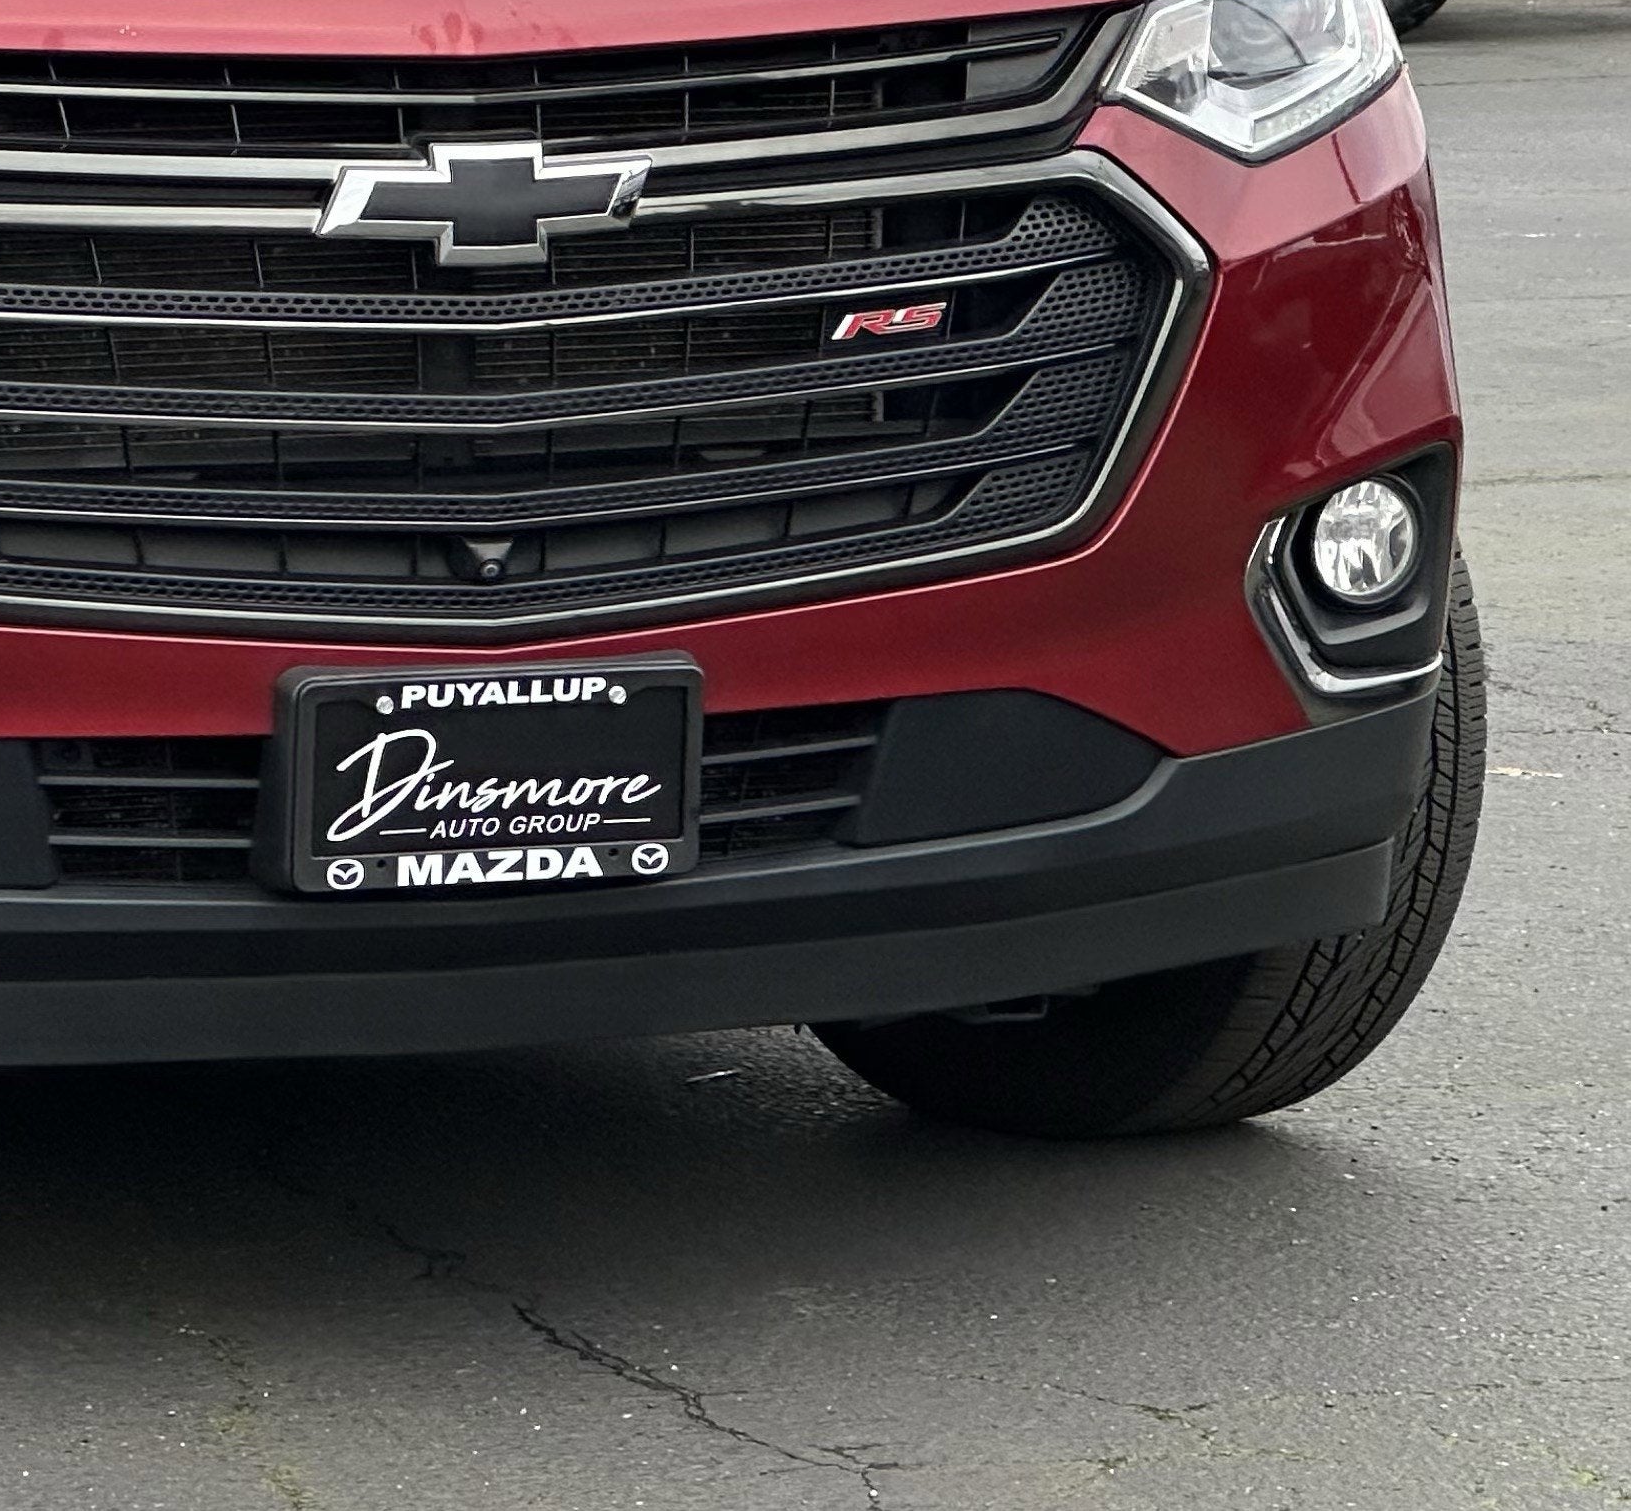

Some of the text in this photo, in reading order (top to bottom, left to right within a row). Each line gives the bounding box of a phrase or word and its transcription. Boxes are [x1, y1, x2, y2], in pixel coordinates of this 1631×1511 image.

[832, 302, 947, 340] RS
[401, 676, 608, 709] PUYALLUP
[326, 728, 663, 842] Dinsmore
[429, 813, 602, 839] AUTO GROUP
[396, 846, 604, 887] MAZDA
